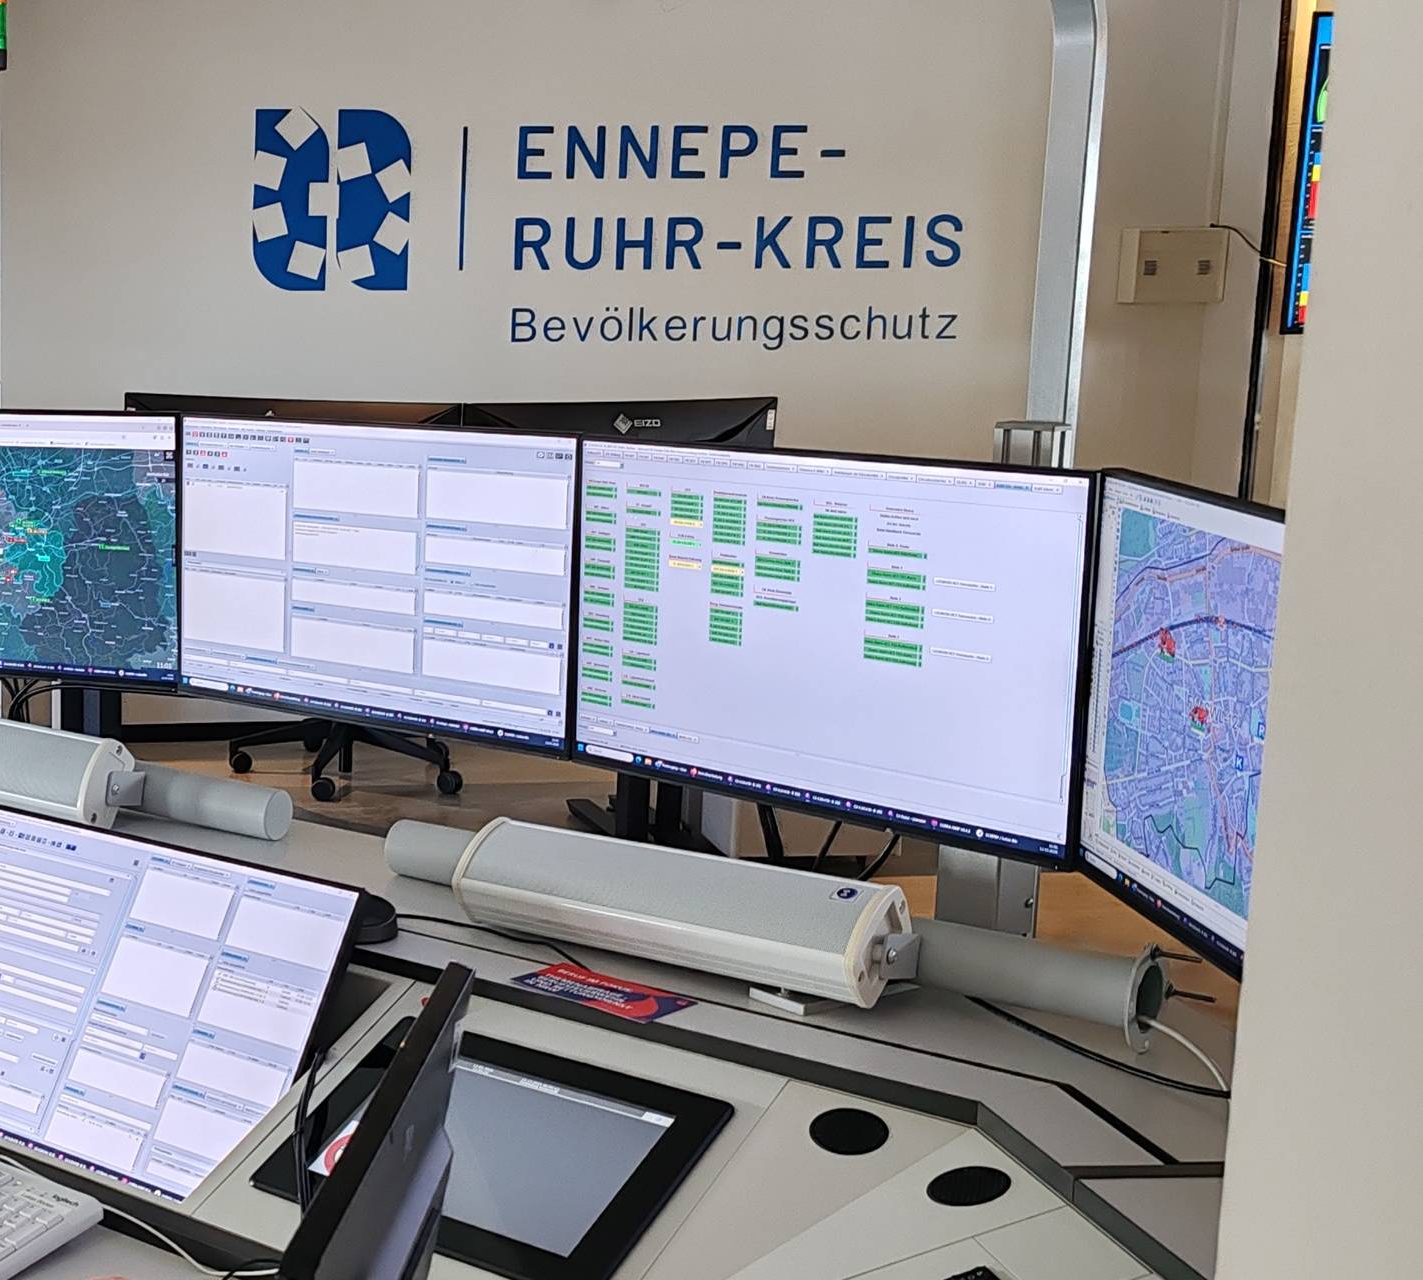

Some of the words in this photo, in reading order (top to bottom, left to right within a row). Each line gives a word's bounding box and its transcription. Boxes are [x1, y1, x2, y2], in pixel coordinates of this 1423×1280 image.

[516, 124, 847, 180] ENNEPE-
[512, 213, 965, 272] RUHR-KREIS
[509, 305, 958, 351] Bevölkerungsschutz
[633, 419, 661, 427] EIZO
